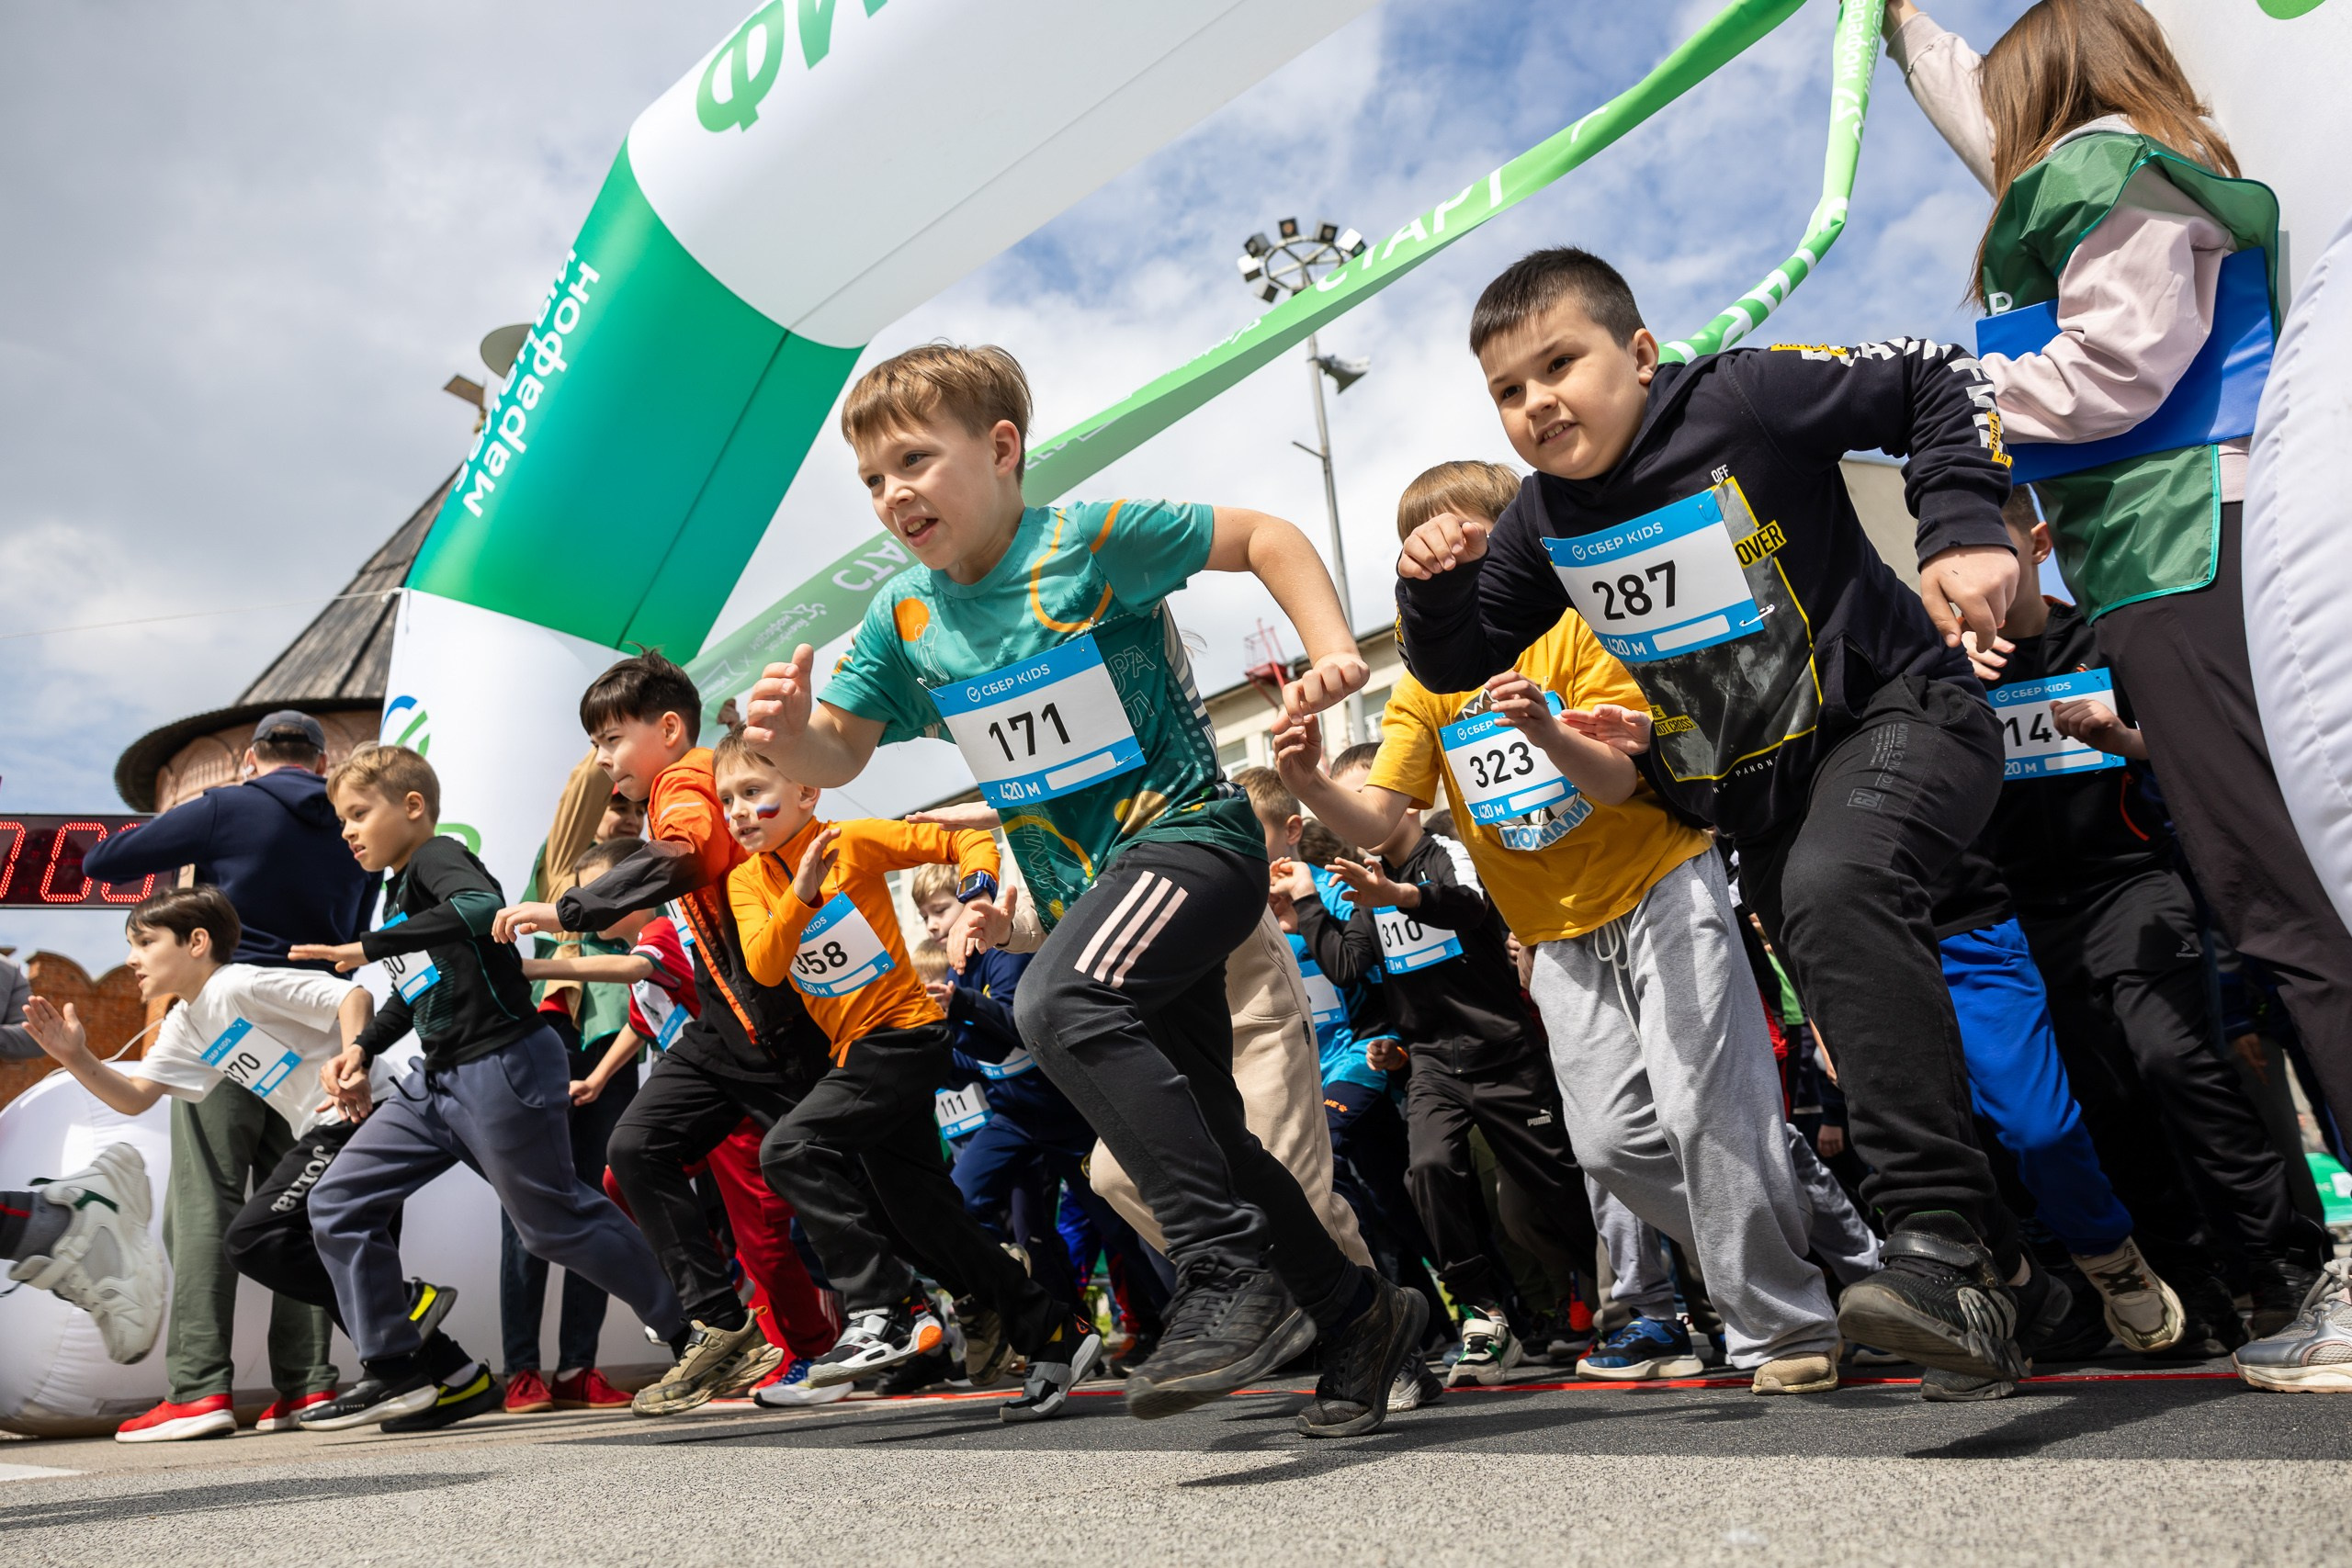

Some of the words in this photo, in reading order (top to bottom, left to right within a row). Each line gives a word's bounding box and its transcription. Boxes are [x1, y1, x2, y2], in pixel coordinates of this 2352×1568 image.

[462, 261, 600, 518] марафон
[1711, 464, 1730, 484] OFF
[1587, 536, 1624, 557] СБЕР
[1626, 521, 1664, 545] KIDS
[1735, 523, 1784, 567] OVER
[1591, 559, 1677, 621] 287
[1610, 638, 1631, 657] 420
[981, 677, 1015, 698] СБЕР
[1016, 663, 1051, 686] KIDS
[2011, 686, 2042, 700] СБЕР
[2043, 681, 2072, 694] KIDS
[988, 702, 1071, 761] 171
[1467, 719, 1494, 736] СБЕР
[2005, 712, 2069, 748] 14
[1469, 741, 1534, 789] 323
[2005, 761, 2022, 775] 20
[999, 781, 1024, 800] 420
[1478, 803, 1494, 819] 420
[1501, 798, 1591, 849] ПОГНАЛИ
[804, 916, 828, 935] KIDS
[1382, 919, 1424, 949] 310
[940, 1093, 967, 1118] 111
[270, 1145, 335, 1213] Joma
